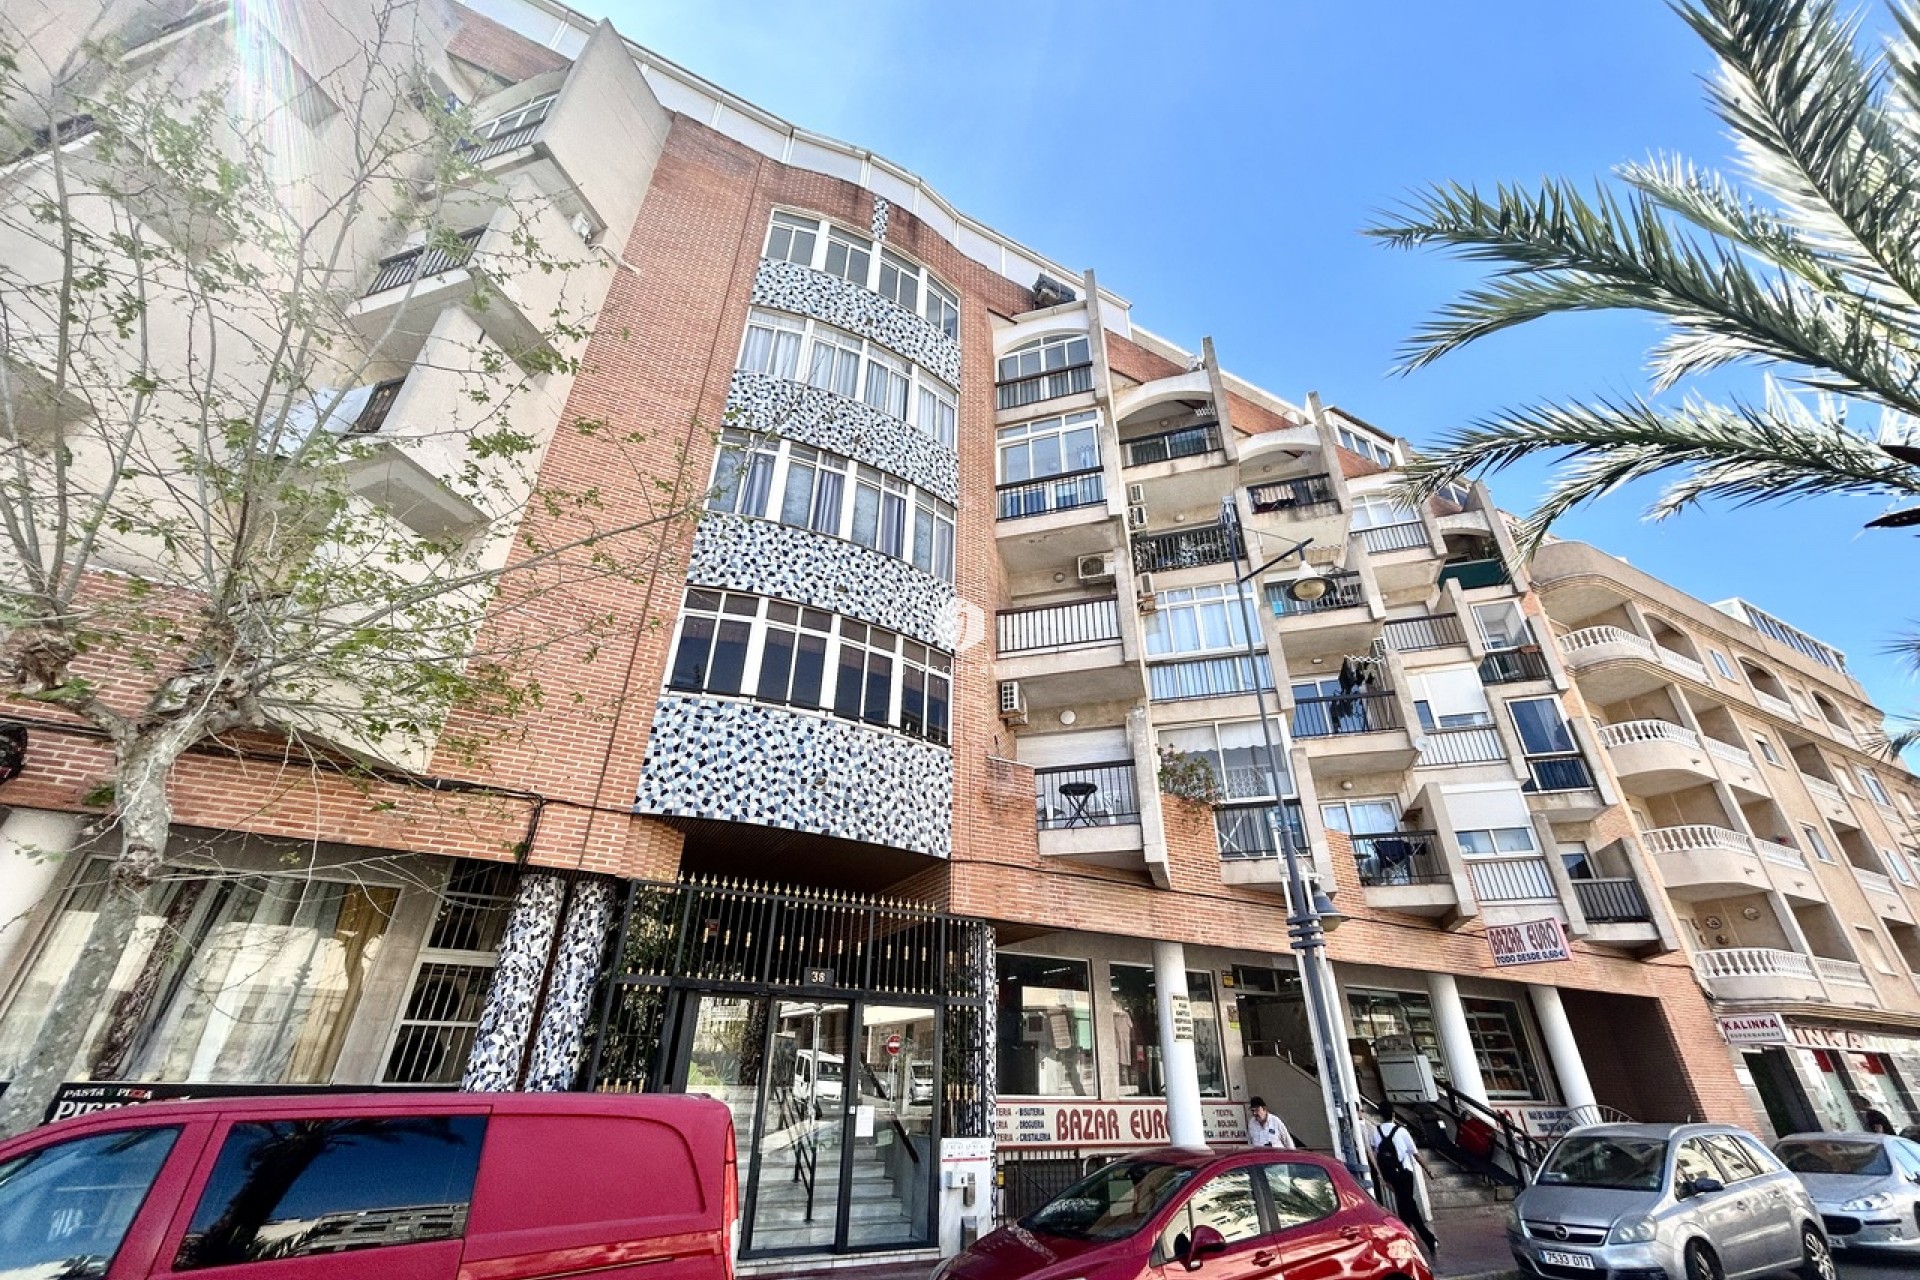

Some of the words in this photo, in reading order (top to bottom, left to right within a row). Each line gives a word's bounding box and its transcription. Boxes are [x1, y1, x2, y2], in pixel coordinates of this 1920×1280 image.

[1489, 927, 1526, 955] BAZAR
[1526, 921, 1558, 950] EURO
[1723, 1019, 1778, 1031] KALINKA
[63, 1088, 105, 1098] PASTA
[117, 1088, 153, 1100] PIZZA
[1056, 1109, 1120, 1141] BAZAR
